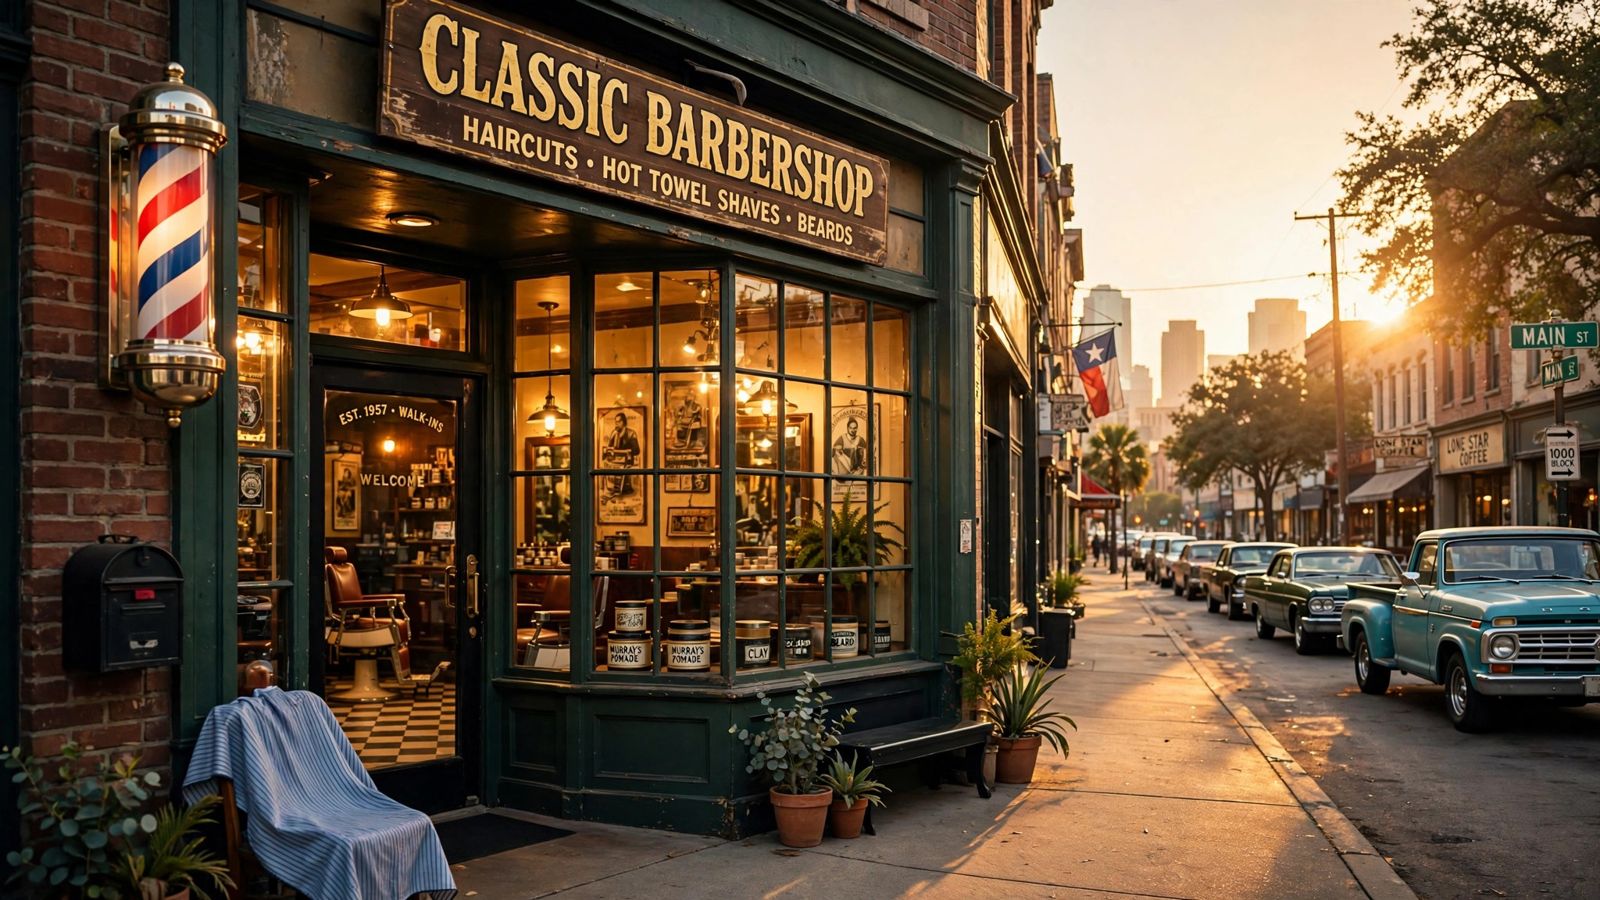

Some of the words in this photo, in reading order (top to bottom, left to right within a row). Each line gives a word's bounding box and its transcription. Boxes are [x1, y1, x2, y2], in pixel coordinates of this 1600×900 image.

[419, 14, 629, 145] CLASSIC
[646, 91, 874, 217] BARBERSHOP
[463, 115, 578, 170] HAIRCUTS
[603, 157, 641, 187] HOT
[650, 169, 711, 208] TOWEL
[718, 190, 780, 225] SHAVES
[798, 215, 853, 246] BEARDS
[1522, 327, 1565, 346] MAIN
[1576, 331, 1589, 344] ST
[1544, 362, 1563, 382] MAIN
[338, 408, 362, 426] EST.
[364, 404, 388, 417] 1957
[399, 405, 444, 433] WALK-INS
[1447, 437, 1465, 454] LONE
[1468, 431, 1489, 450] STAR
[1460, 449, 1488, 466] COFFEE
[1550, 448, 1575, 459] 1000
[1551, 460, 1574, 468] BLOCK
[360, 473, 425, 488] WELCOME
[748, 647, 769, 660] CLAY
